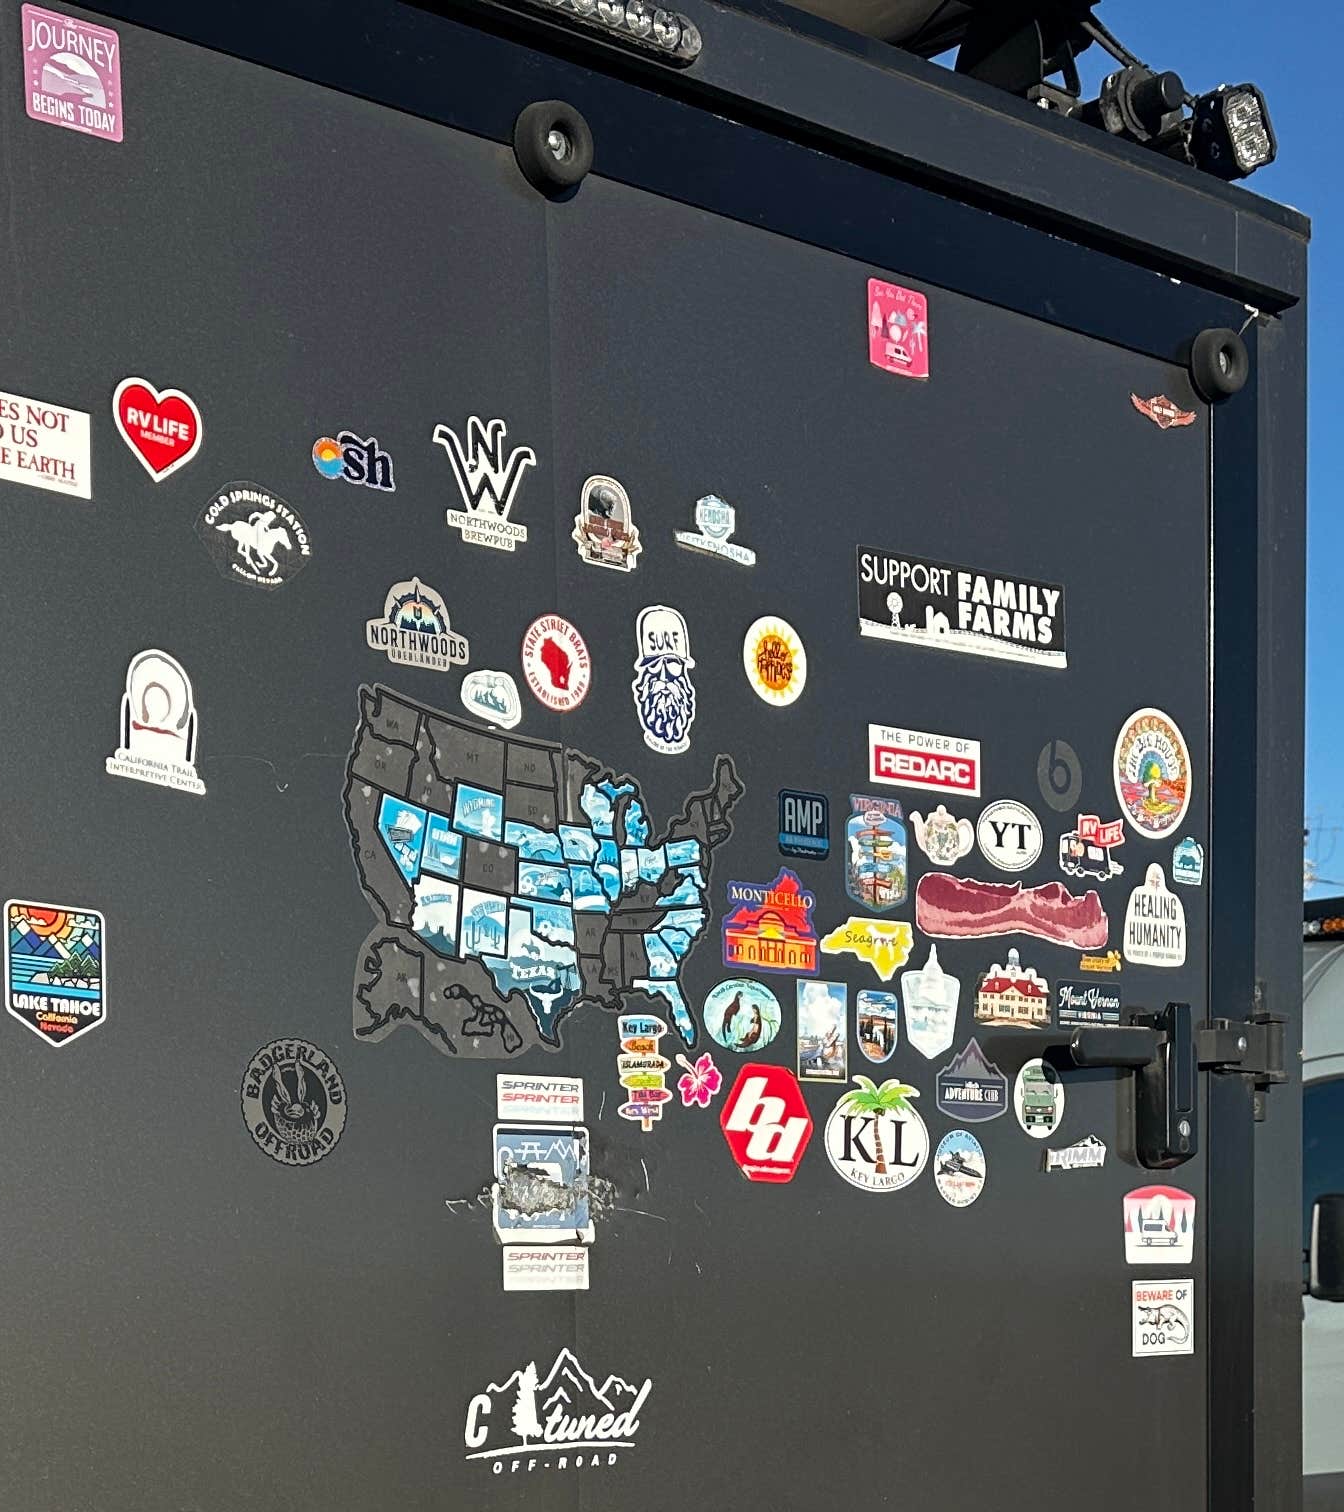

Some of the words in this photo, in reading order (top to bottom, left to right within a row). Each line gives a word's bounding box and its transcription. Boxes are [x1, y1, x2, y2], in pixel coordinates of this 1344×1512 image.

[27, 19, 115, 73] JOURNEY
[32, 92, 74, 121] BEGINS
[78, 104, 115, 132] TODAY
[26, 404, 69, 432] NOT
[126, 407, 151, 426] RV
[153, 416, 190, 441] LIFE
[11, 425, 38, 447] US
[140, 429, 175, 447] MEMBER
[17, 450, 75, 480] EARTH
[205, 494, 229, 525] COLD
[230, 490, 276, 511] SPRINGS
[275, 505, 310, 556] STATION
[450, 513, 526, 538] NORTHWOODS
[464, 530, 513, 549] BREWPUB
[860, 553, 952, 596] SUPPORT
[958, 571, 1060, 617] FAMILY
[958, 601, 1053, 644] FARMS
[370, 624, 466, 660] NORTHWOODS
[524, 624, 543, 657] STATE
[541, 617, 568, 635] STREET
[569, 630, 588, 669] BRATS
[648, 631, 679, 651] SURF
[528, 671, 570, 706] ESTABLISHED
[881, 730, 902, 743] THE
[909, 734, 950, 751] POWER
[956, 741, 970, 753] OF
[109, 761, 167, 782] INTERPRETIVE
[118, 752, 169, 771] CALIFORNIA
[172, 764, 194, 777] TRAIL
[879, 751, 971, 785] REDARC
[785, 797, 823, 835] AMP
[852, 797, 902, 817] VIRGINIA
[989, 821, 1032, 850] YT
[1083, 819, 1097, 838] RV
[1099, 825, 1120, 843] LIFE
[731, 886, 813, 909] MONTICELLO
[1134, 894, 1176, 920] HEALING
[1129, 922, 1182, 949] HUMANITY
[511, 962, 556, 979] TEXAS
[12, 994, 48, 1011] LAKE
[50, 998, 100, 1017] TAHOE
[1058, 986, 1087, 1009] Mount
[1087, 988, 1120, 1010] Vernon
[36, 1012, 78, 1024] California
[40, 1022, 74, 1033] Nevada
[623, 1022, 637, 1034] Key
[639, 1021, 662, 1034] Largo
[246, 1043, 343, 1105] BADGERLAND
[501, 1080, 579, 1092] SPRINTER
[501, 1093, 580, 1105] SPRINTER
[945, 1088, 983, 1102] ADVENTURE
[984, 1089, 998, 1102] CLUB
[255, 1120, 334, 1161] OFFROAD
[850, 1167, 870, 1184] KEY
[872, 1171, 906, 1187] LARGO
[508, 1252, 585, 1262] SPRINTER
[508, 1263, 585, 1274] SPRINTER
[1136, 1289, 1173, 1301] BEWARE
[1175, 1289, 1187, 1301] OF
[1142, 1332, 1166, 1345] DOG
[543, 1378, 652, 1443] tuned
[492, 1452, 617, 1475] OFF-ROAD
